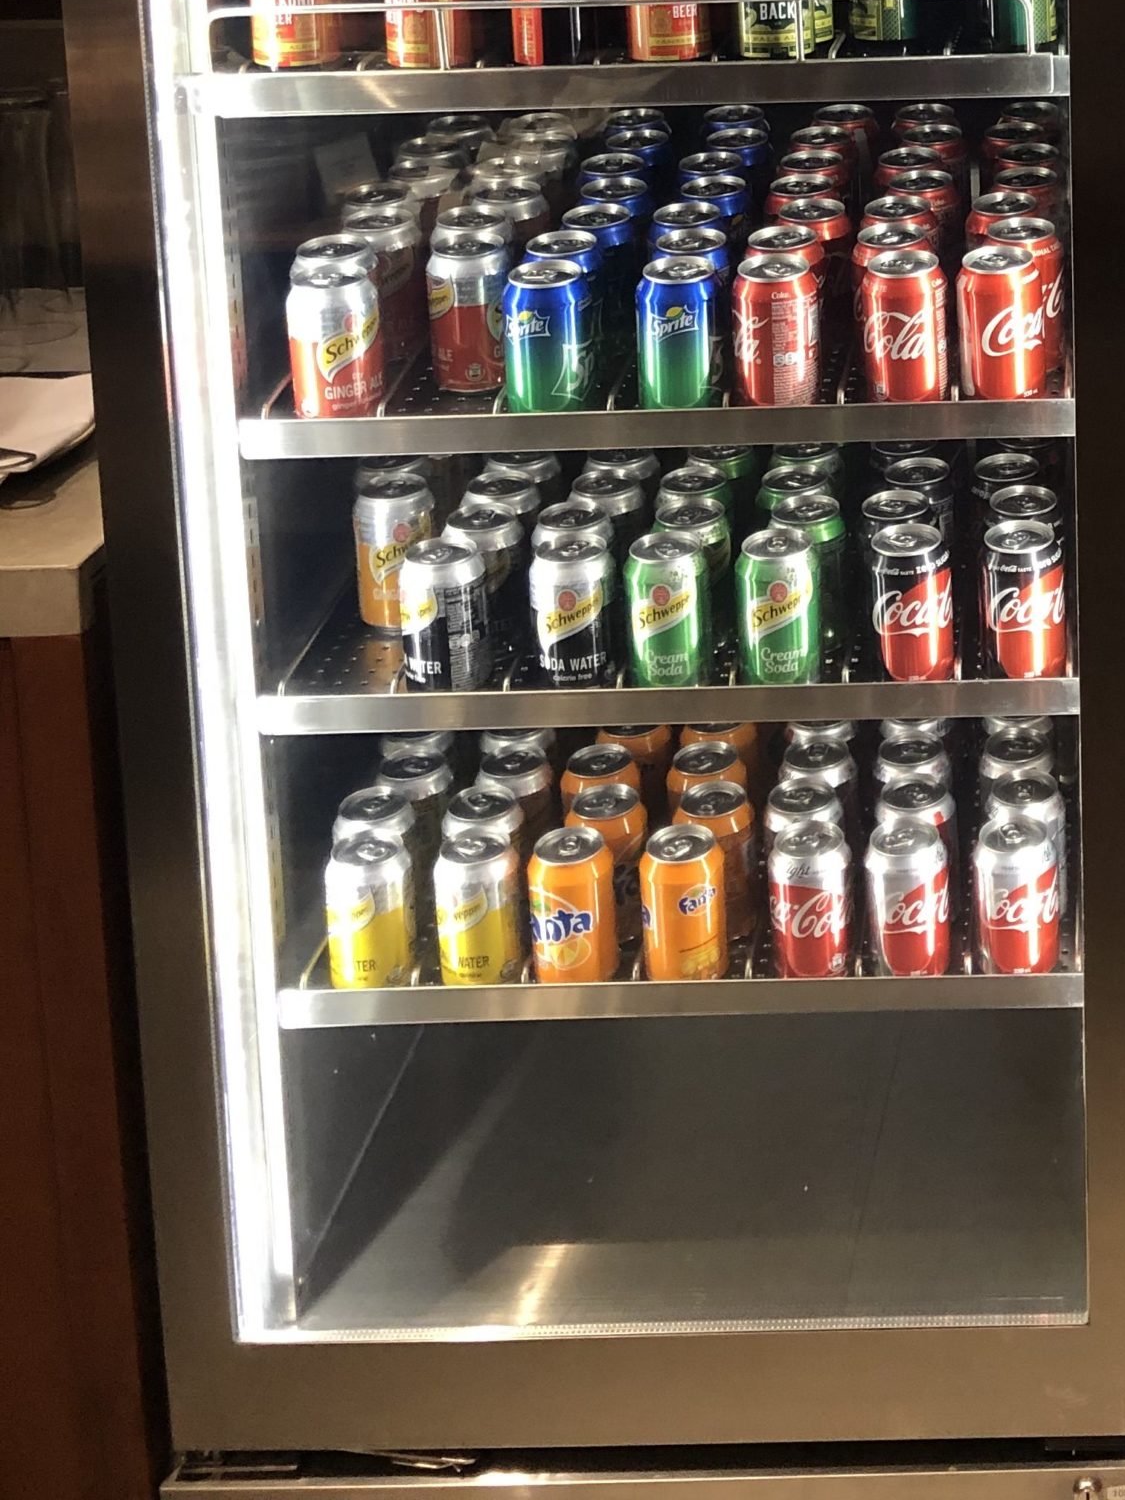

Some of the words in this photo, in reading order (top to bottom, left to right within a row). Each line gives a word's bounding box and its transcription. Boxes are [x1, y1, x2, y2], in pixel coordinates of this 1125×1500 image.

[672, 4, 697, 18] BEER
[760, 0, 797, 21] BACK
[652, 313, 694, 340] Sprite
[325, 380, 368, 399] GINGER
[570, 652, 607, 671] WATER
[645, 650, 689, 664] Cream
[649, 663, 683, 677] Soda
[764, 660, 798, 674] Soda
[458, 956, 490, 969] WATER
